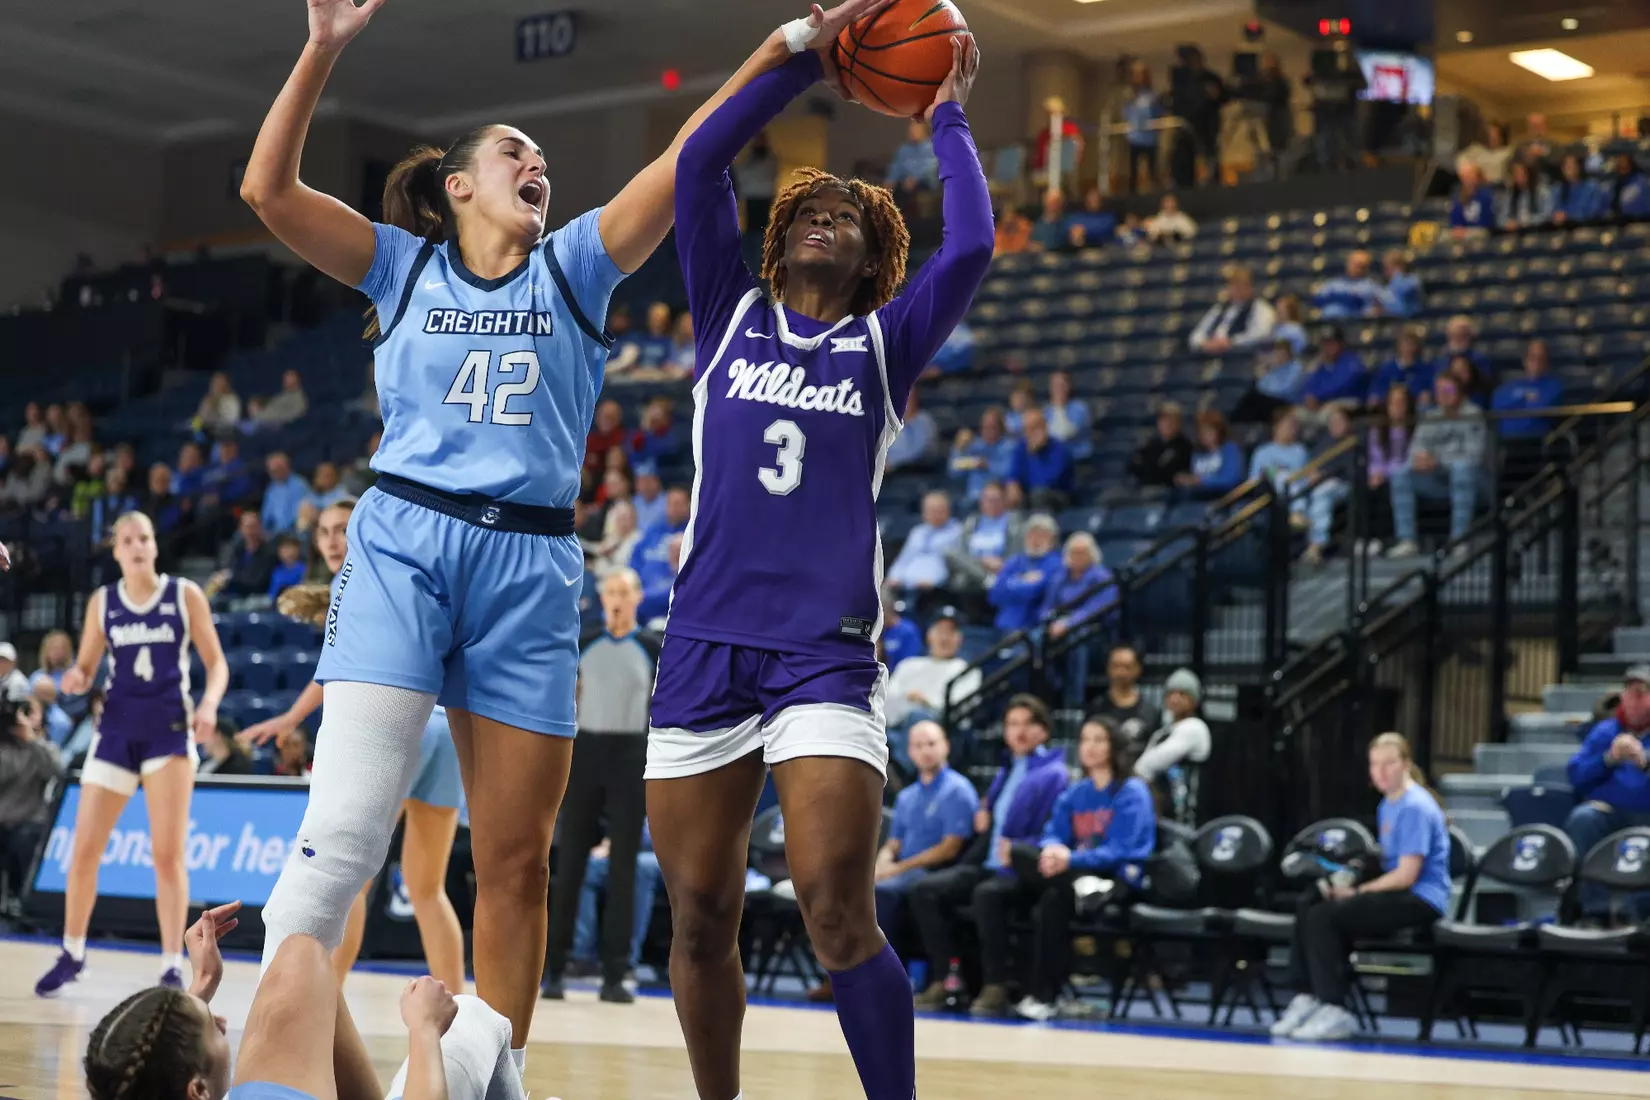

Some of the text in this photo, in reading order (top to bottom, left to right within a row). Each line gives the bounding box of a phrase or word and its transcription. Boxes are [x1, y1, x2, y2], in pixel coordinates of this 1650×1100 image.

[523, 16, 573, 56] 110
[442, 350, 541, 426] 42
[725, 358, 865, 416] Wildcats
[758, 419, 806, 496] 3
[133, 645, 154, 682] 4
